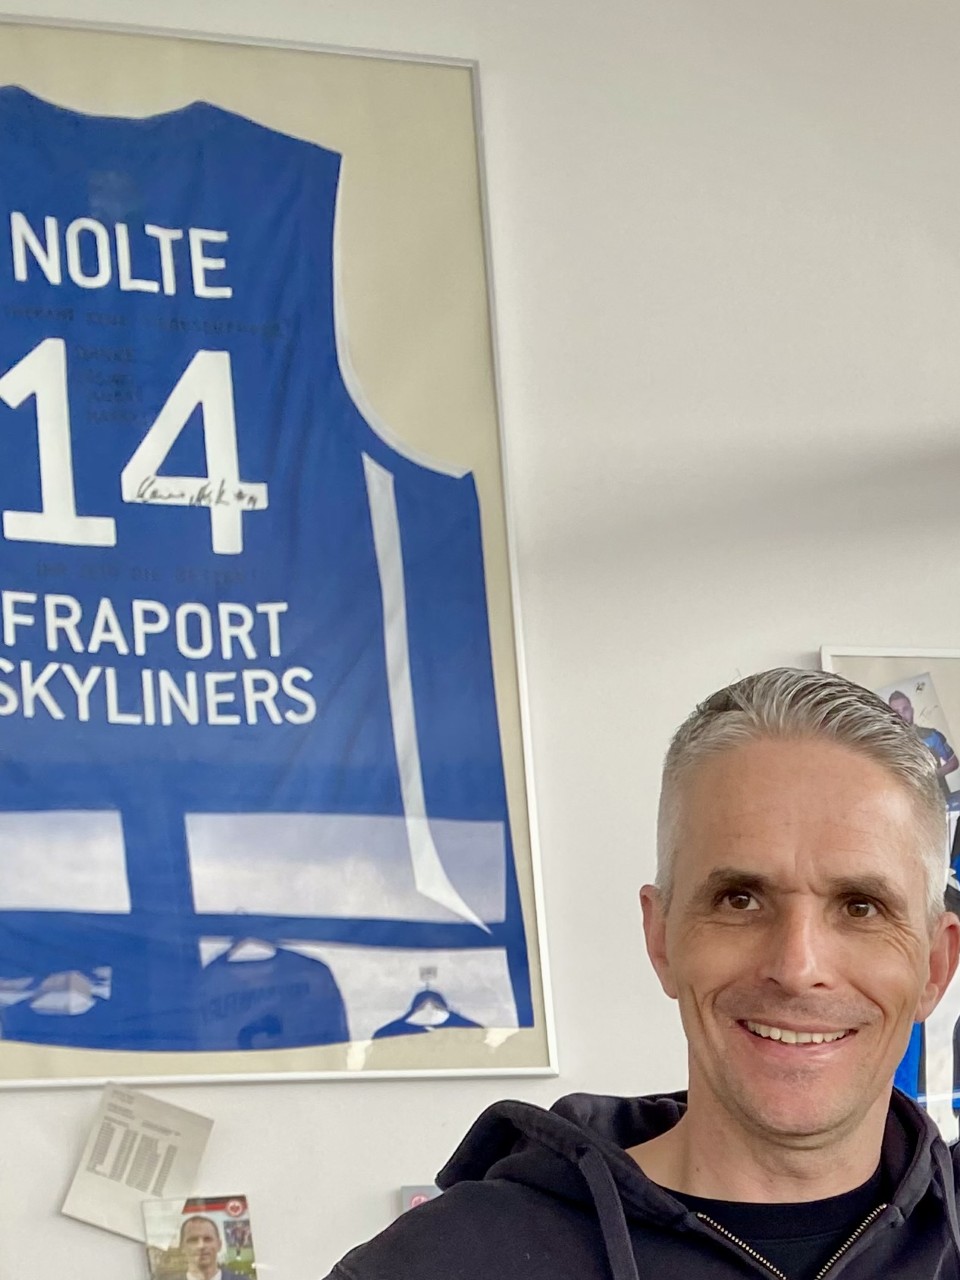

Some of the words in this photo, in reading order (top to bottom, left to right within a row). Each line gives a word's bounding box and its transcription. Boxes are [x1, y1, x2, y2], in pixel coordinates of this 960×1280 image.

[10, 211, 233, 299] NOLTE
[0, 337, 269, 555] 14
[1, 590, 288, 660] FRAPORT
[0, 657, 317, 726] SKYLINERS
